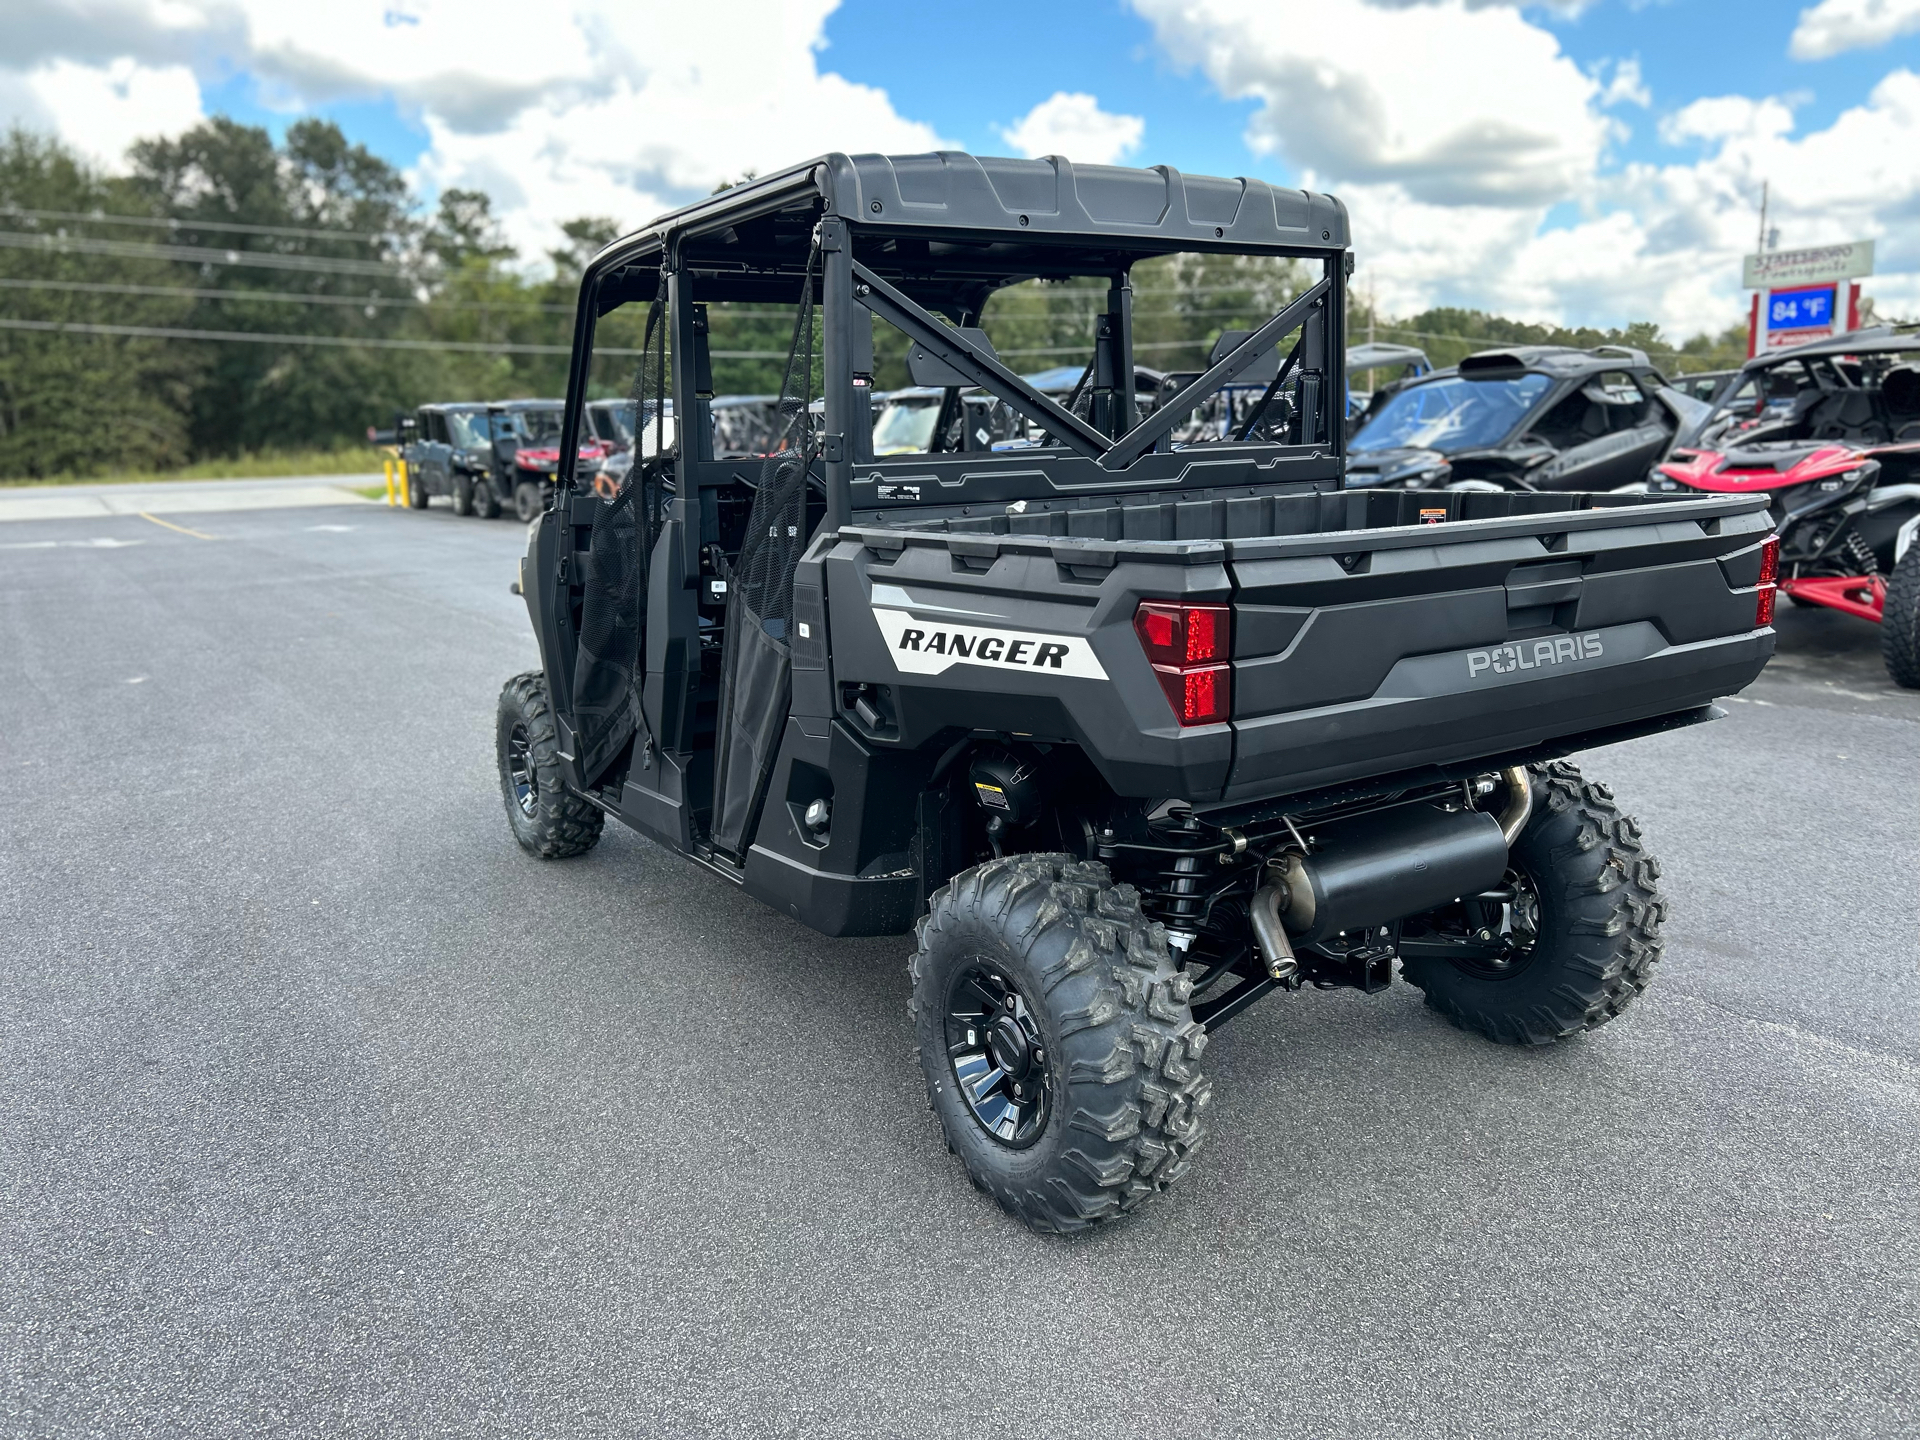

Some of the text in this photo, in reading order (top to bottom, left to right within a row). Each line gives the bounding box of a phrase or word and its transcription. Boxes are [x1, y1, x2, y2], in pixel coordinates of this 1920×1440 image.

[1772, 301, 1797, 321] 84
[898, 628, 1070, 669] RANGER
[1466, 633, 1604, 678] POLARIS
